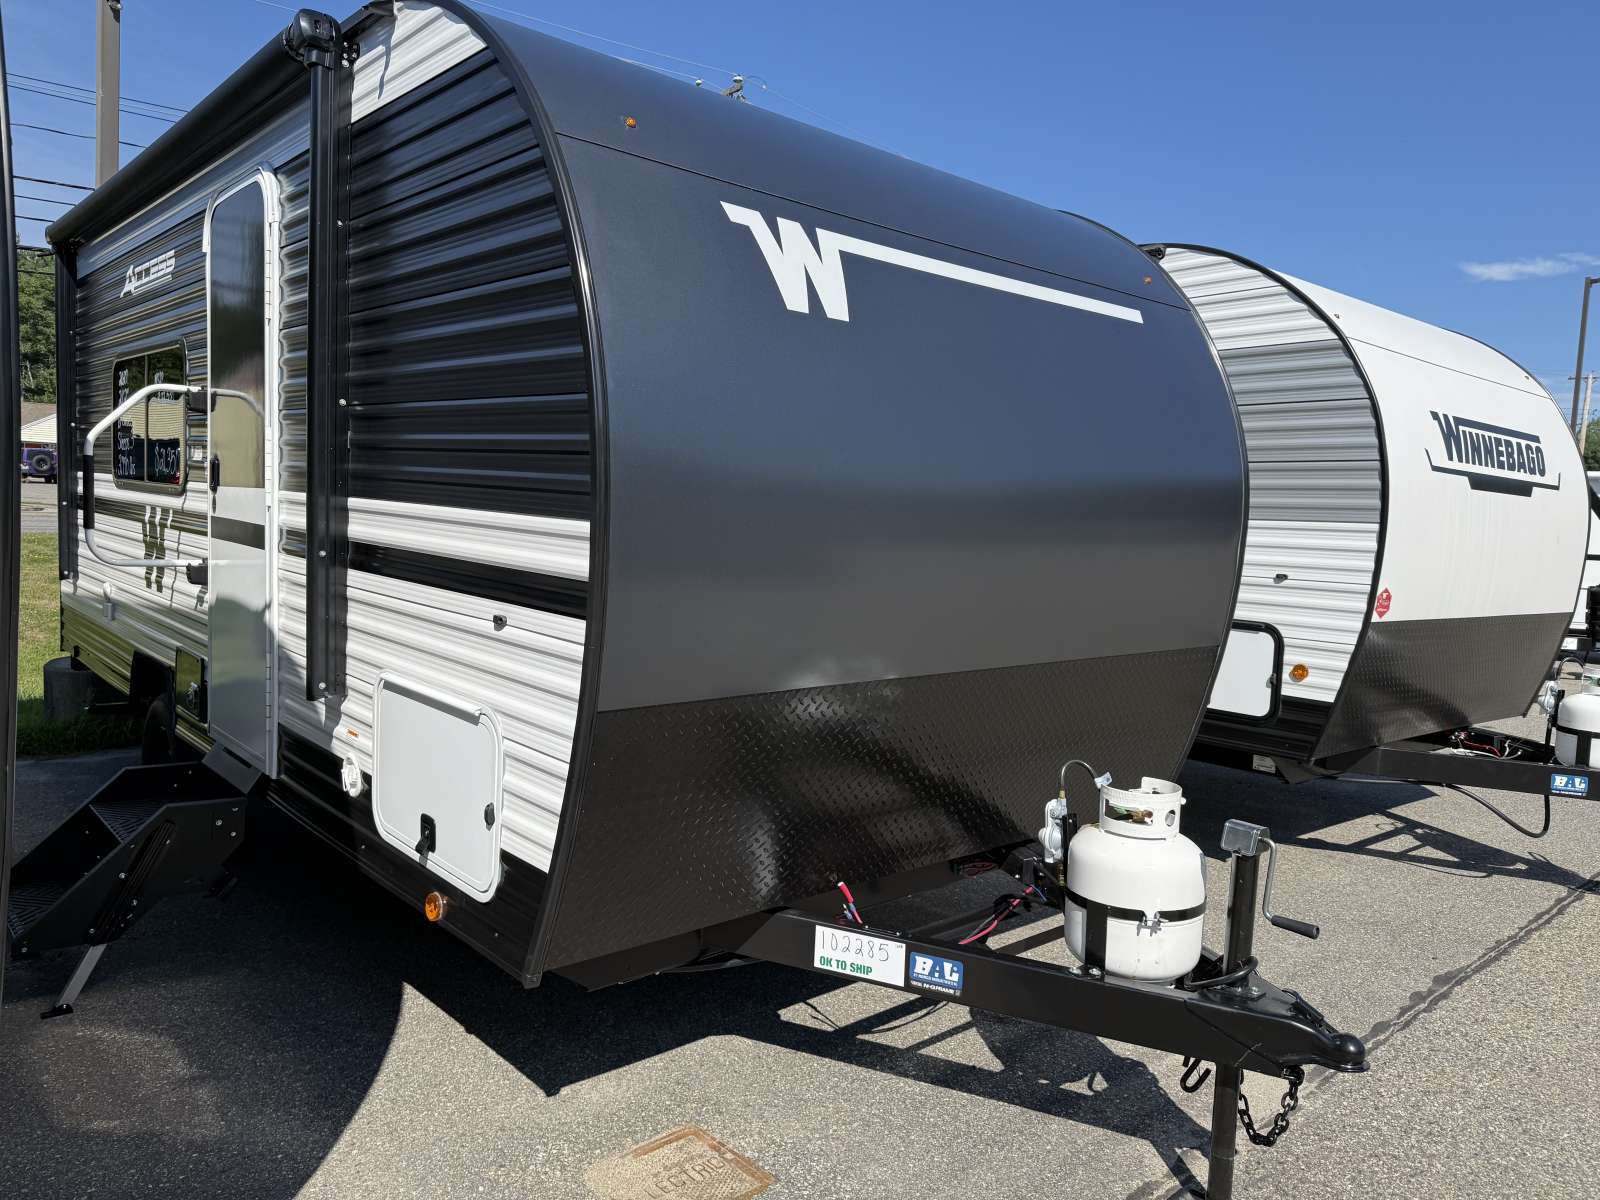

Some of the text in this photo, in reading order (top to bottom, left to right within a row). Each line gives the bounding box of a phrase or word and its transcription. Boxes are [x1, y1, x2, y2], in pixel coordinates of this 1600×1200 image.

[1429, 410, 1546, 478] WINNEBAGO
[822, 930, 889, 962] 102285
[820, 956, 873, 975] OK TO SHIP
[642, 1156, 726, 1199] LECTRIC
